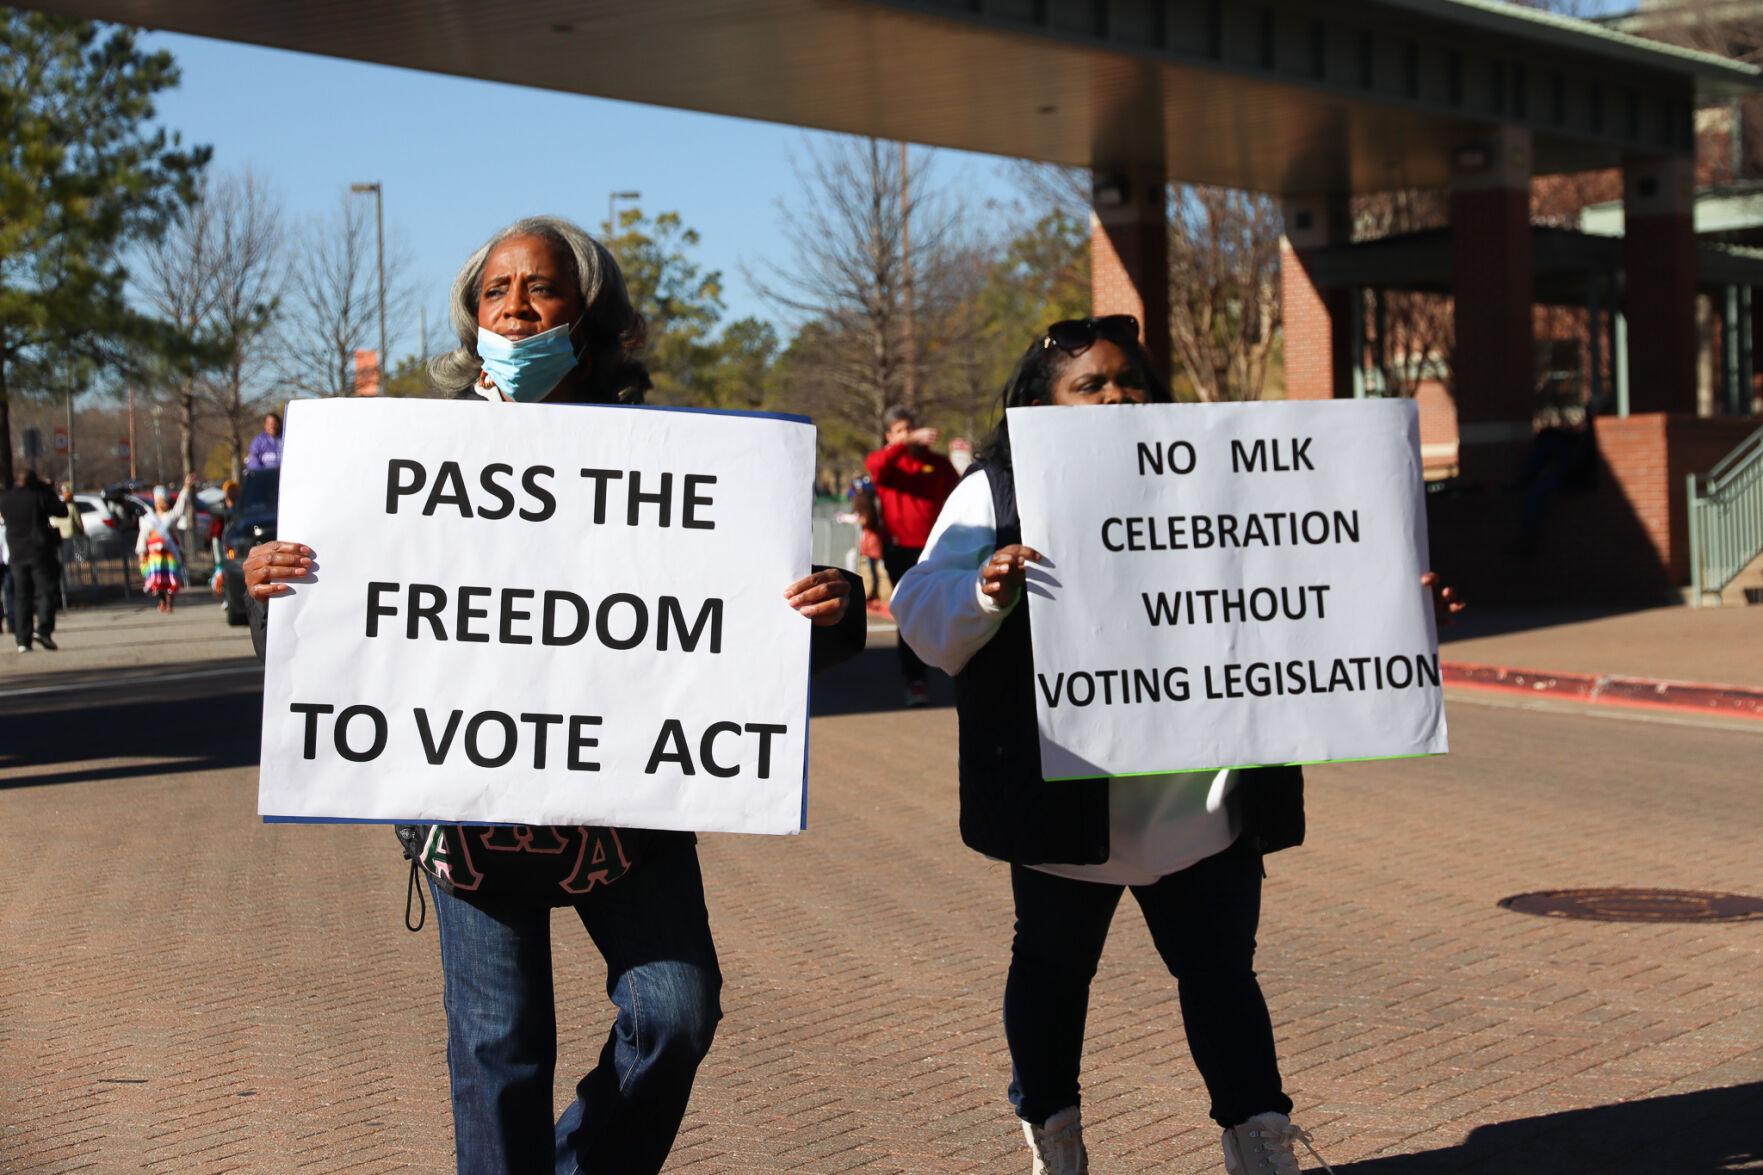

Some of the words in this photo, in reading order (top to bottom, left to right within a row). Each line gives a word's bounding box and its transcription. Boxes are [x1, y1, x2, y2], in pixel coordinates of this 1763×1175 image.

[1137, 441, 1196, 475] NO
[1231, 438, 1314, 473] MLK
[386, 459, 556, 522] PASS
[581, 469, 717, 529] THE
[1102, 510, 1359, 552] CELEBRATION
[366, 582, 723, 653] FREEDOM
[1142, 586, 1330, 626] WITHOUT
[1038, 667, 1190, 708] VOTING
[1204, 654, 1440, 699] LEGISLATION
[290, 703, 387, 762] TO
[414, 708, 602, 771] VOTE
[645, 720, 787, 779] ACT
